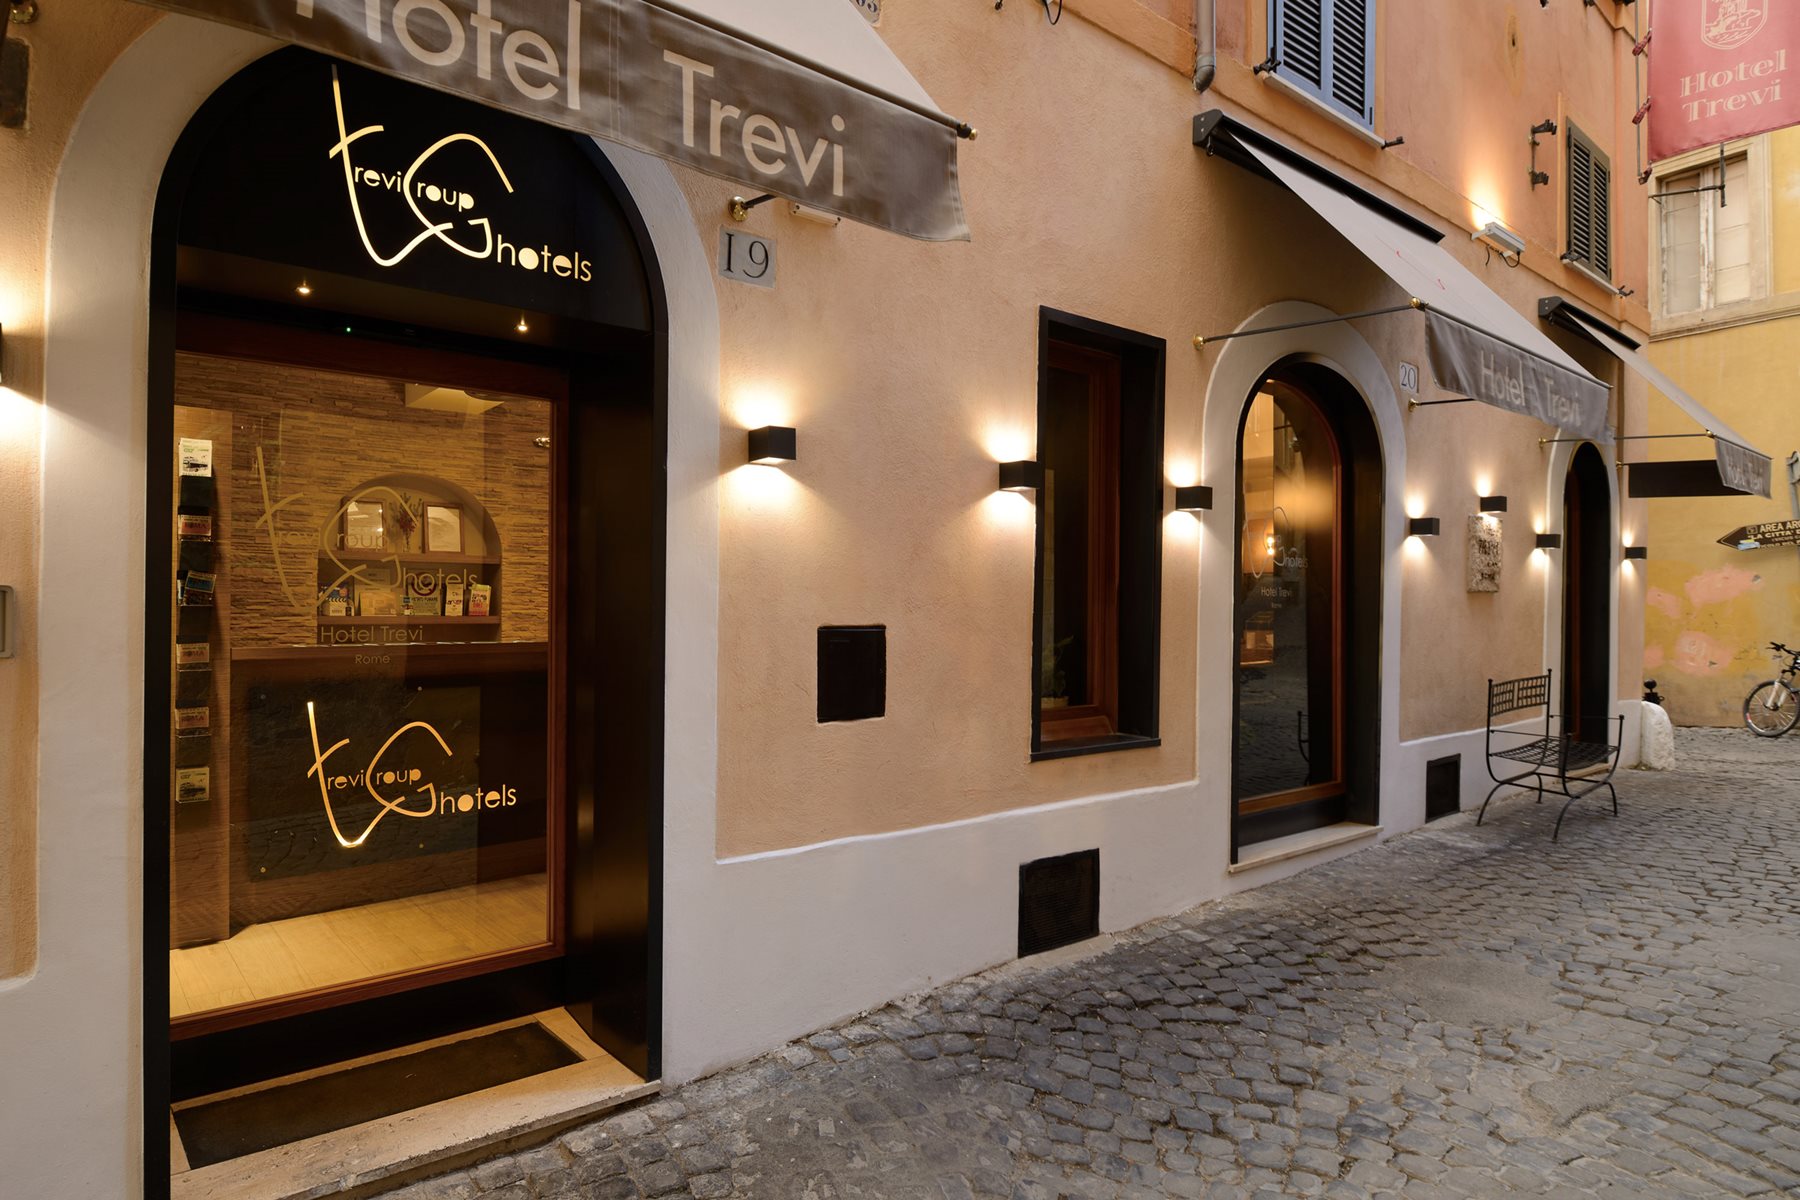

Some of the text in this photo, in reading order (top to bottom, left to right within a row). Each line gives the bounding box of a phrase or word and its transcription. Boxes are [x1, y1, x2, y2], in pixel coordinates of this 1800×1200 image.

[1680, 49, 1787, 97] Hotel
[1682, 79, 1783, 123] Trevi
[663, 50, 844, 197] Trevi
[497, 234, 592, 282] hotels
[724, 233, 769, 278] 19
[1401, 364, 1417, 390] 20
[1481, 350, 1581, 427] Hotel Trevi
[1760, 522, 1784, 533] AREA
[403, 568, 478, 591] hotels
[321, 625, 423, 642] Hotel Trevi
[355, 654, 391, 664] Rome
[440, 784, 517, 814] hotels
